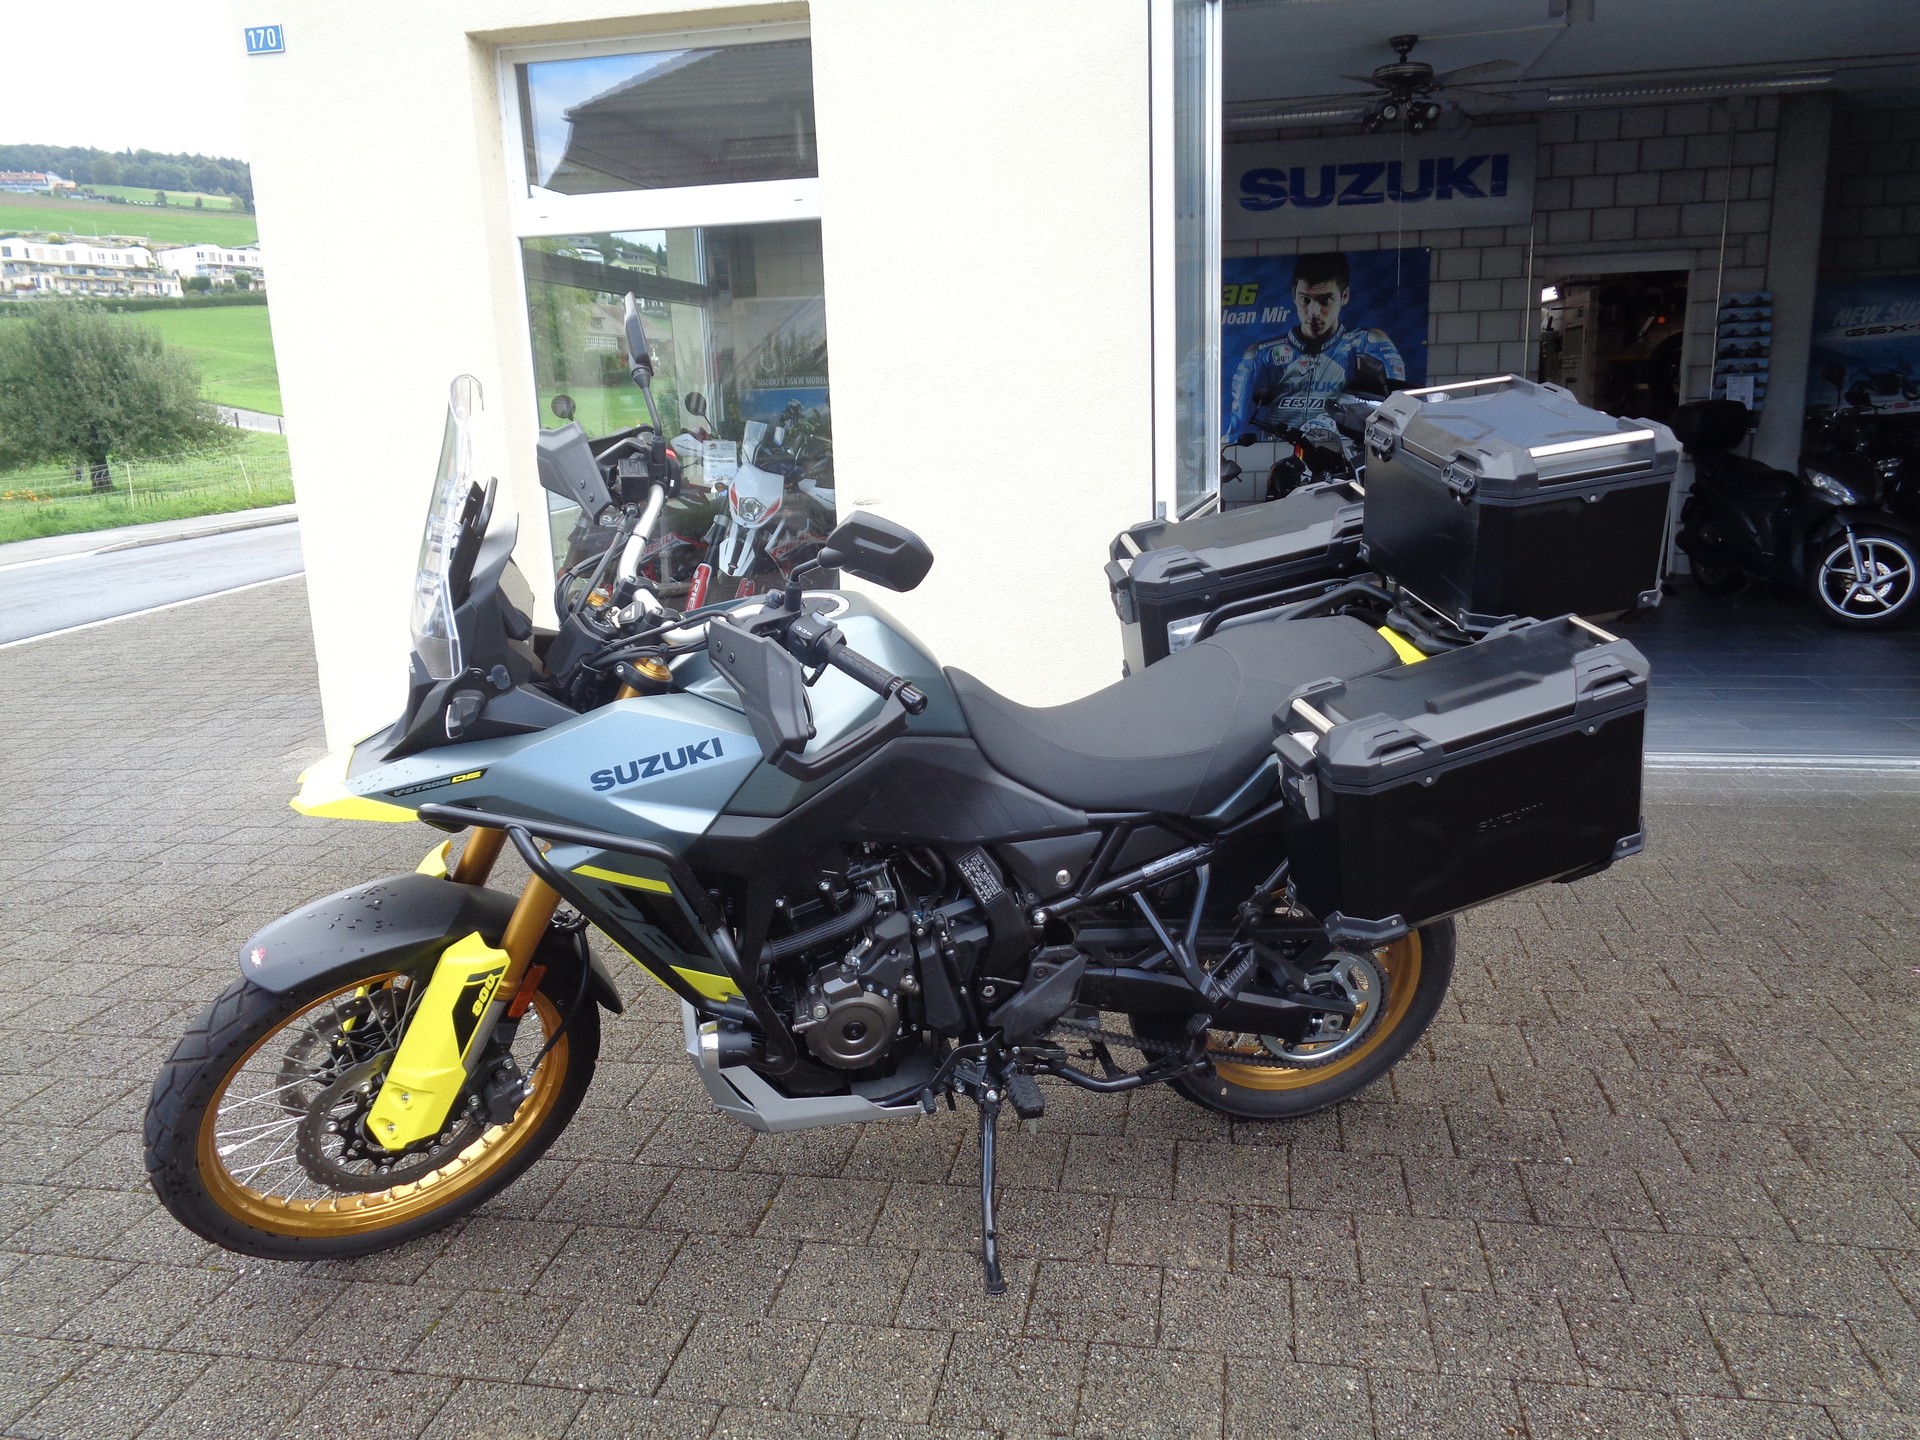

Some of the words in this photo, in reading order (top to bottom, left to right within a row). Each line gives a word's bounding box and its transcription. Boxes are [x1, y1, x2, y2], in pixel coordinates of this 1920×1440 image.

[247, 27, 277, 49] 170
[1239, 153, 1509, 212] SUZUKI
[1222, 283, 1259, 306] 36
[1221, 309, 1257, 326] Joan
[1260, 305, 1292, 324] Mir
[1832, 304, 1885, 328] NEW
[1884, 300, 1920, 321] SU
[1845, 322, 1920, 337] GSX-
[1279, 397, 1325, 409] ECSTA
[589, 736, 725, 792] SUZUKI
[471, 973, 496, 1017] 800
